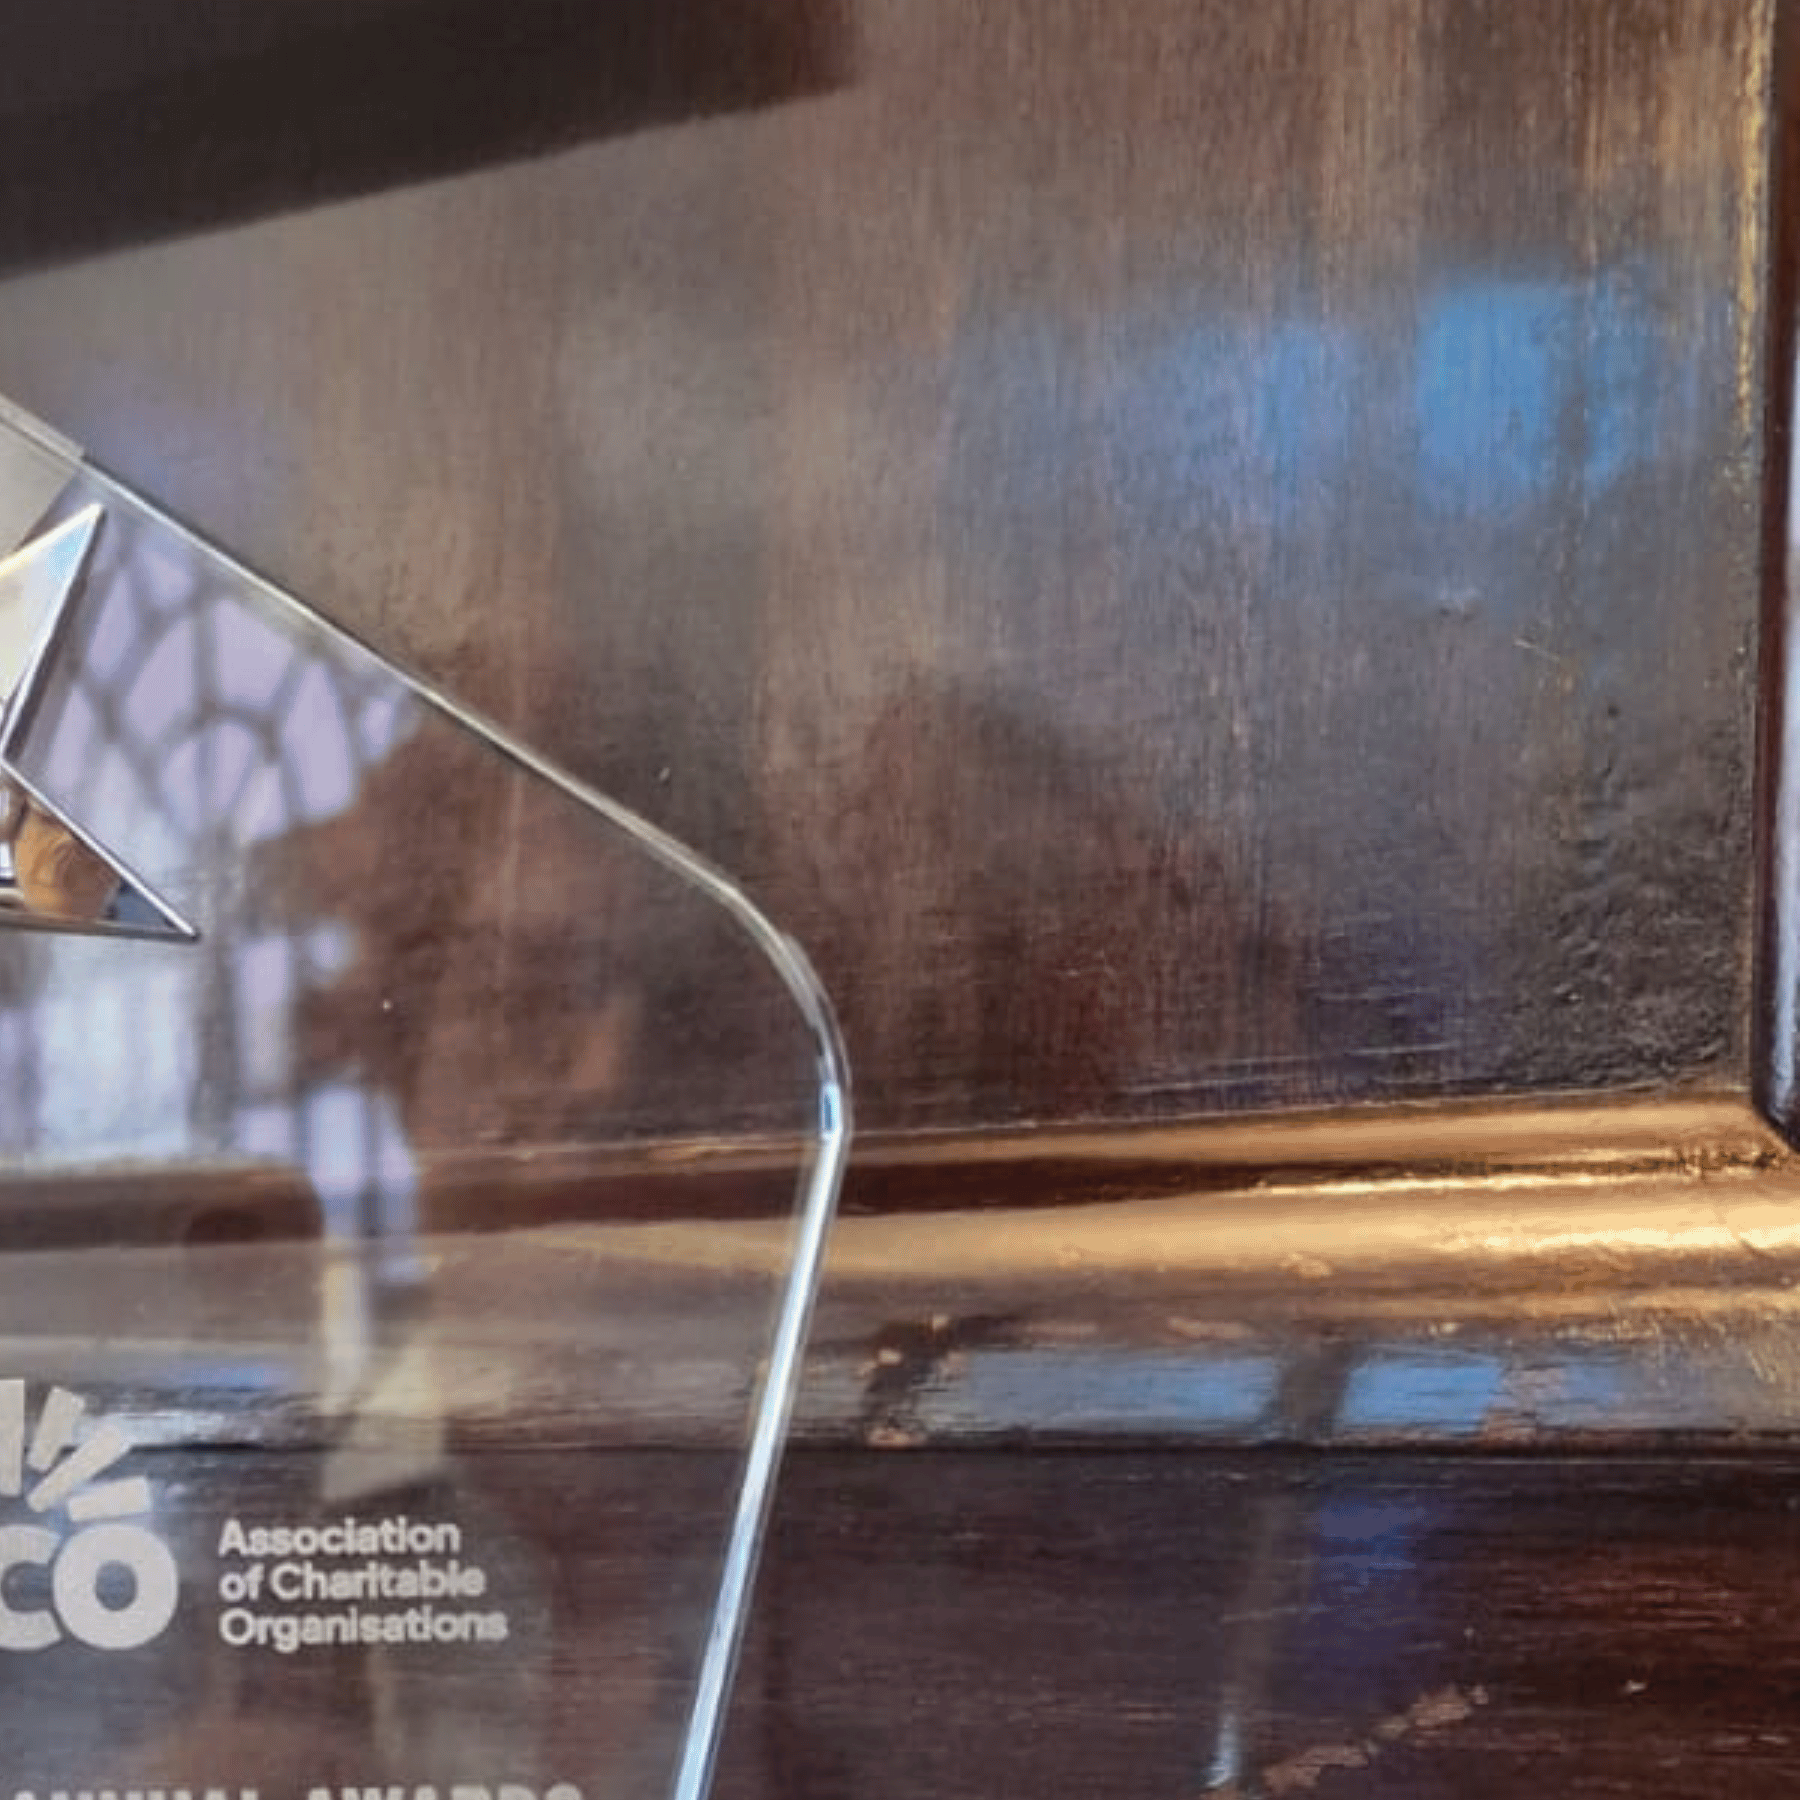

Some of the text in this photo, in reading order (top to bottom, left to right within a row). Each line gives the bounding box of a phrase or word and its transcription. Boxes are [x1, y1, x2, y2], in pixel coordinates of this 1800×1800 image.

[219, 1517, 460, 1556] Association
[220, 1561, 486, 1599] of Charitable
[219, 1606, 508, 1653] Organisations
